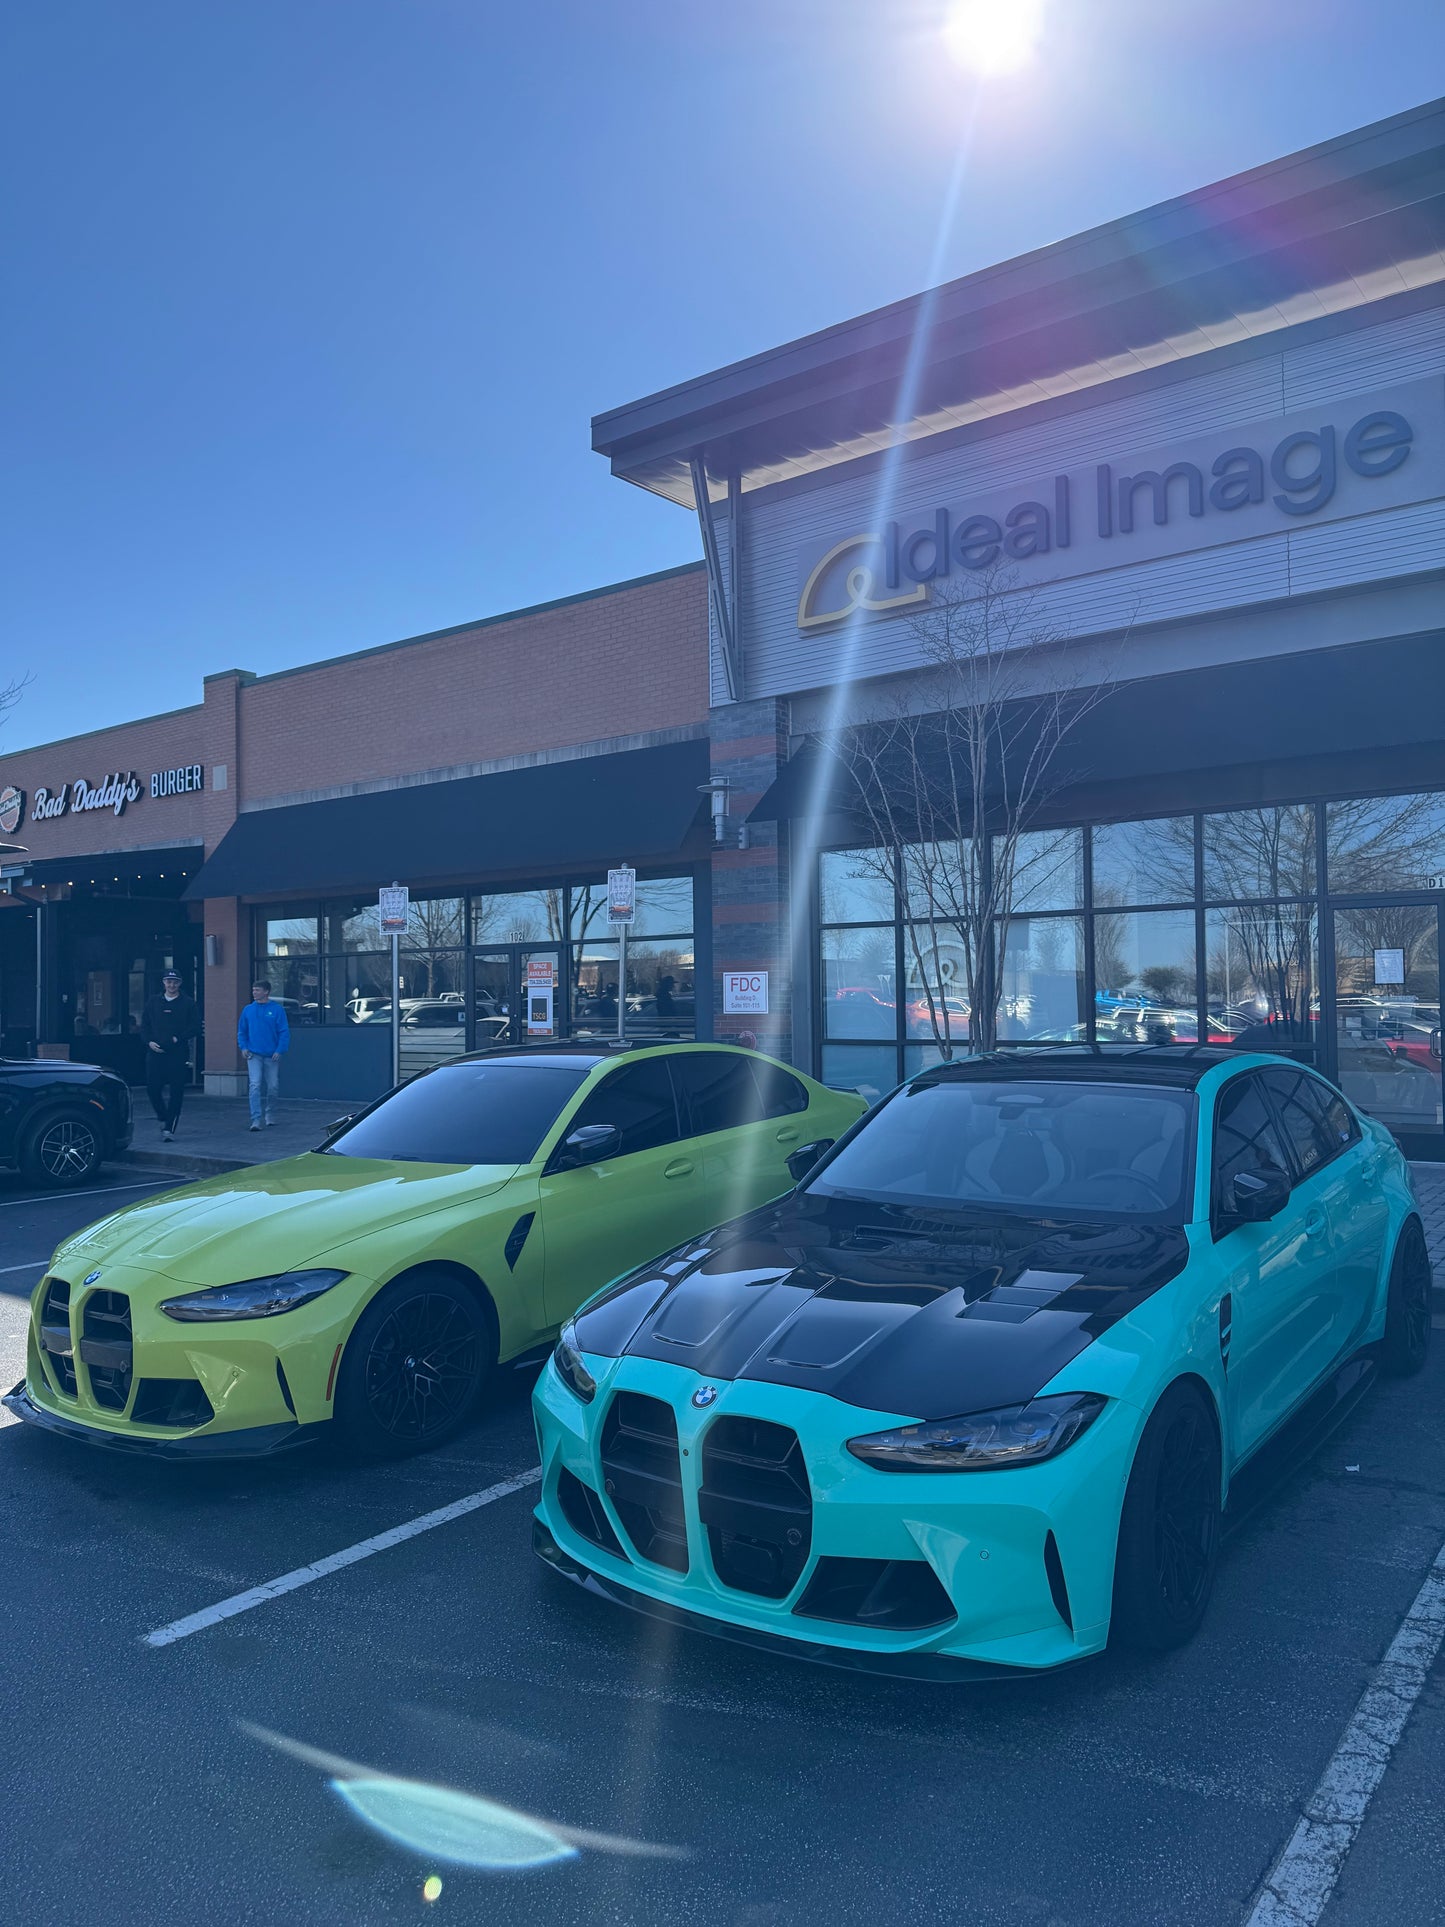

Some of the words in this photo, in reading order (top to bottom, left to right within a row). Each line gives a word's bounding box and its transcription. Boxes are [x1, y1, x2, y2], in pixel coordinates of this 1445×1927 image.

[885, 475, 1069, 589] Ideal
[1098, 410, 1414, 538] Image
[32, 784, 67, 821] Bad
[71, 771, 140, 816] Daddy's
[151, 764, 202, 798] BURGER
[510, 931, 523, 942] 102
[731, 976, 760, 992] FDC
